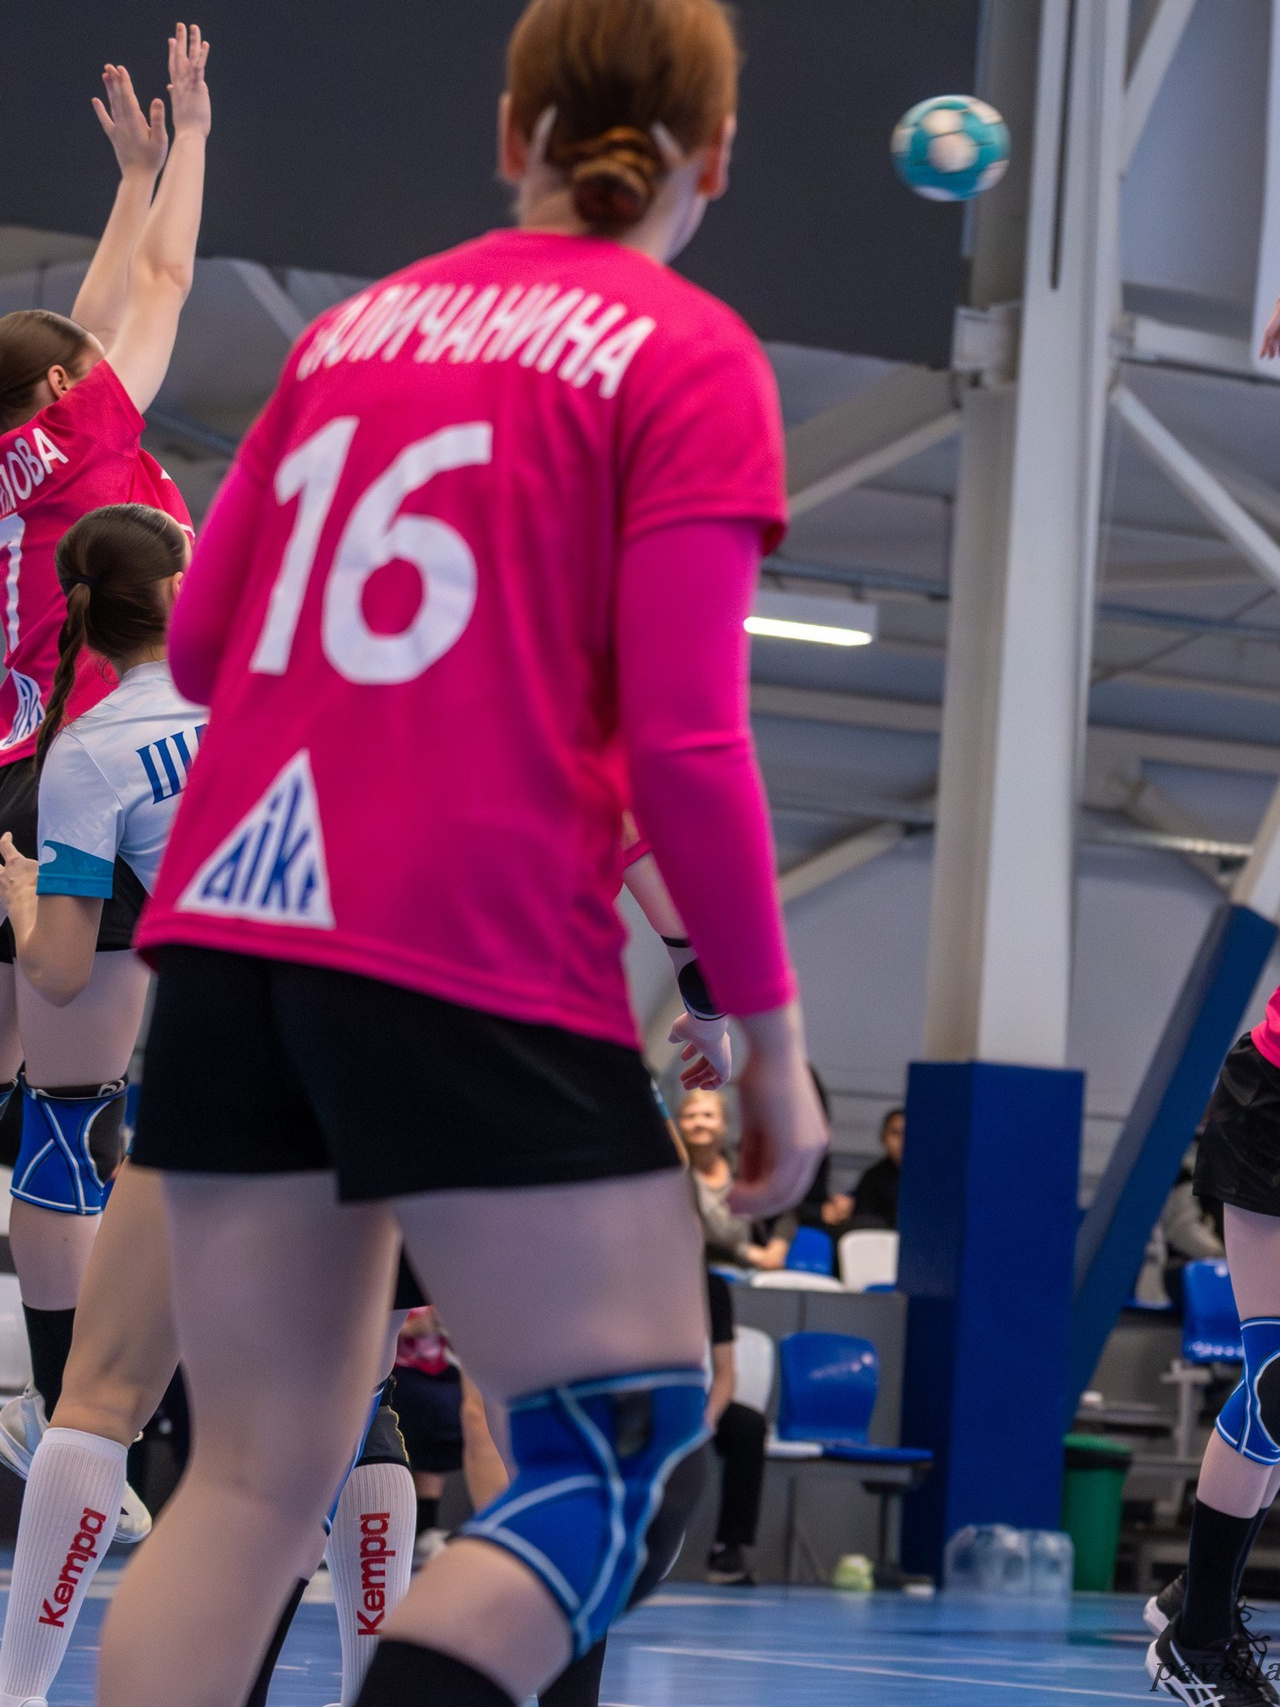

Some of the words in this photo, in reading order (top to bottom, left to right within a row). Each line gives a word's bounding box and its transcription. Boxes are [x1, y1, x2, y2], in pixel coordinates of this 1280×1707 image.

[250, 414, 493, 686] 16
[38, 1506, 107, 1628] Kempa
[357, 1511, 397, 1636] Kempa
